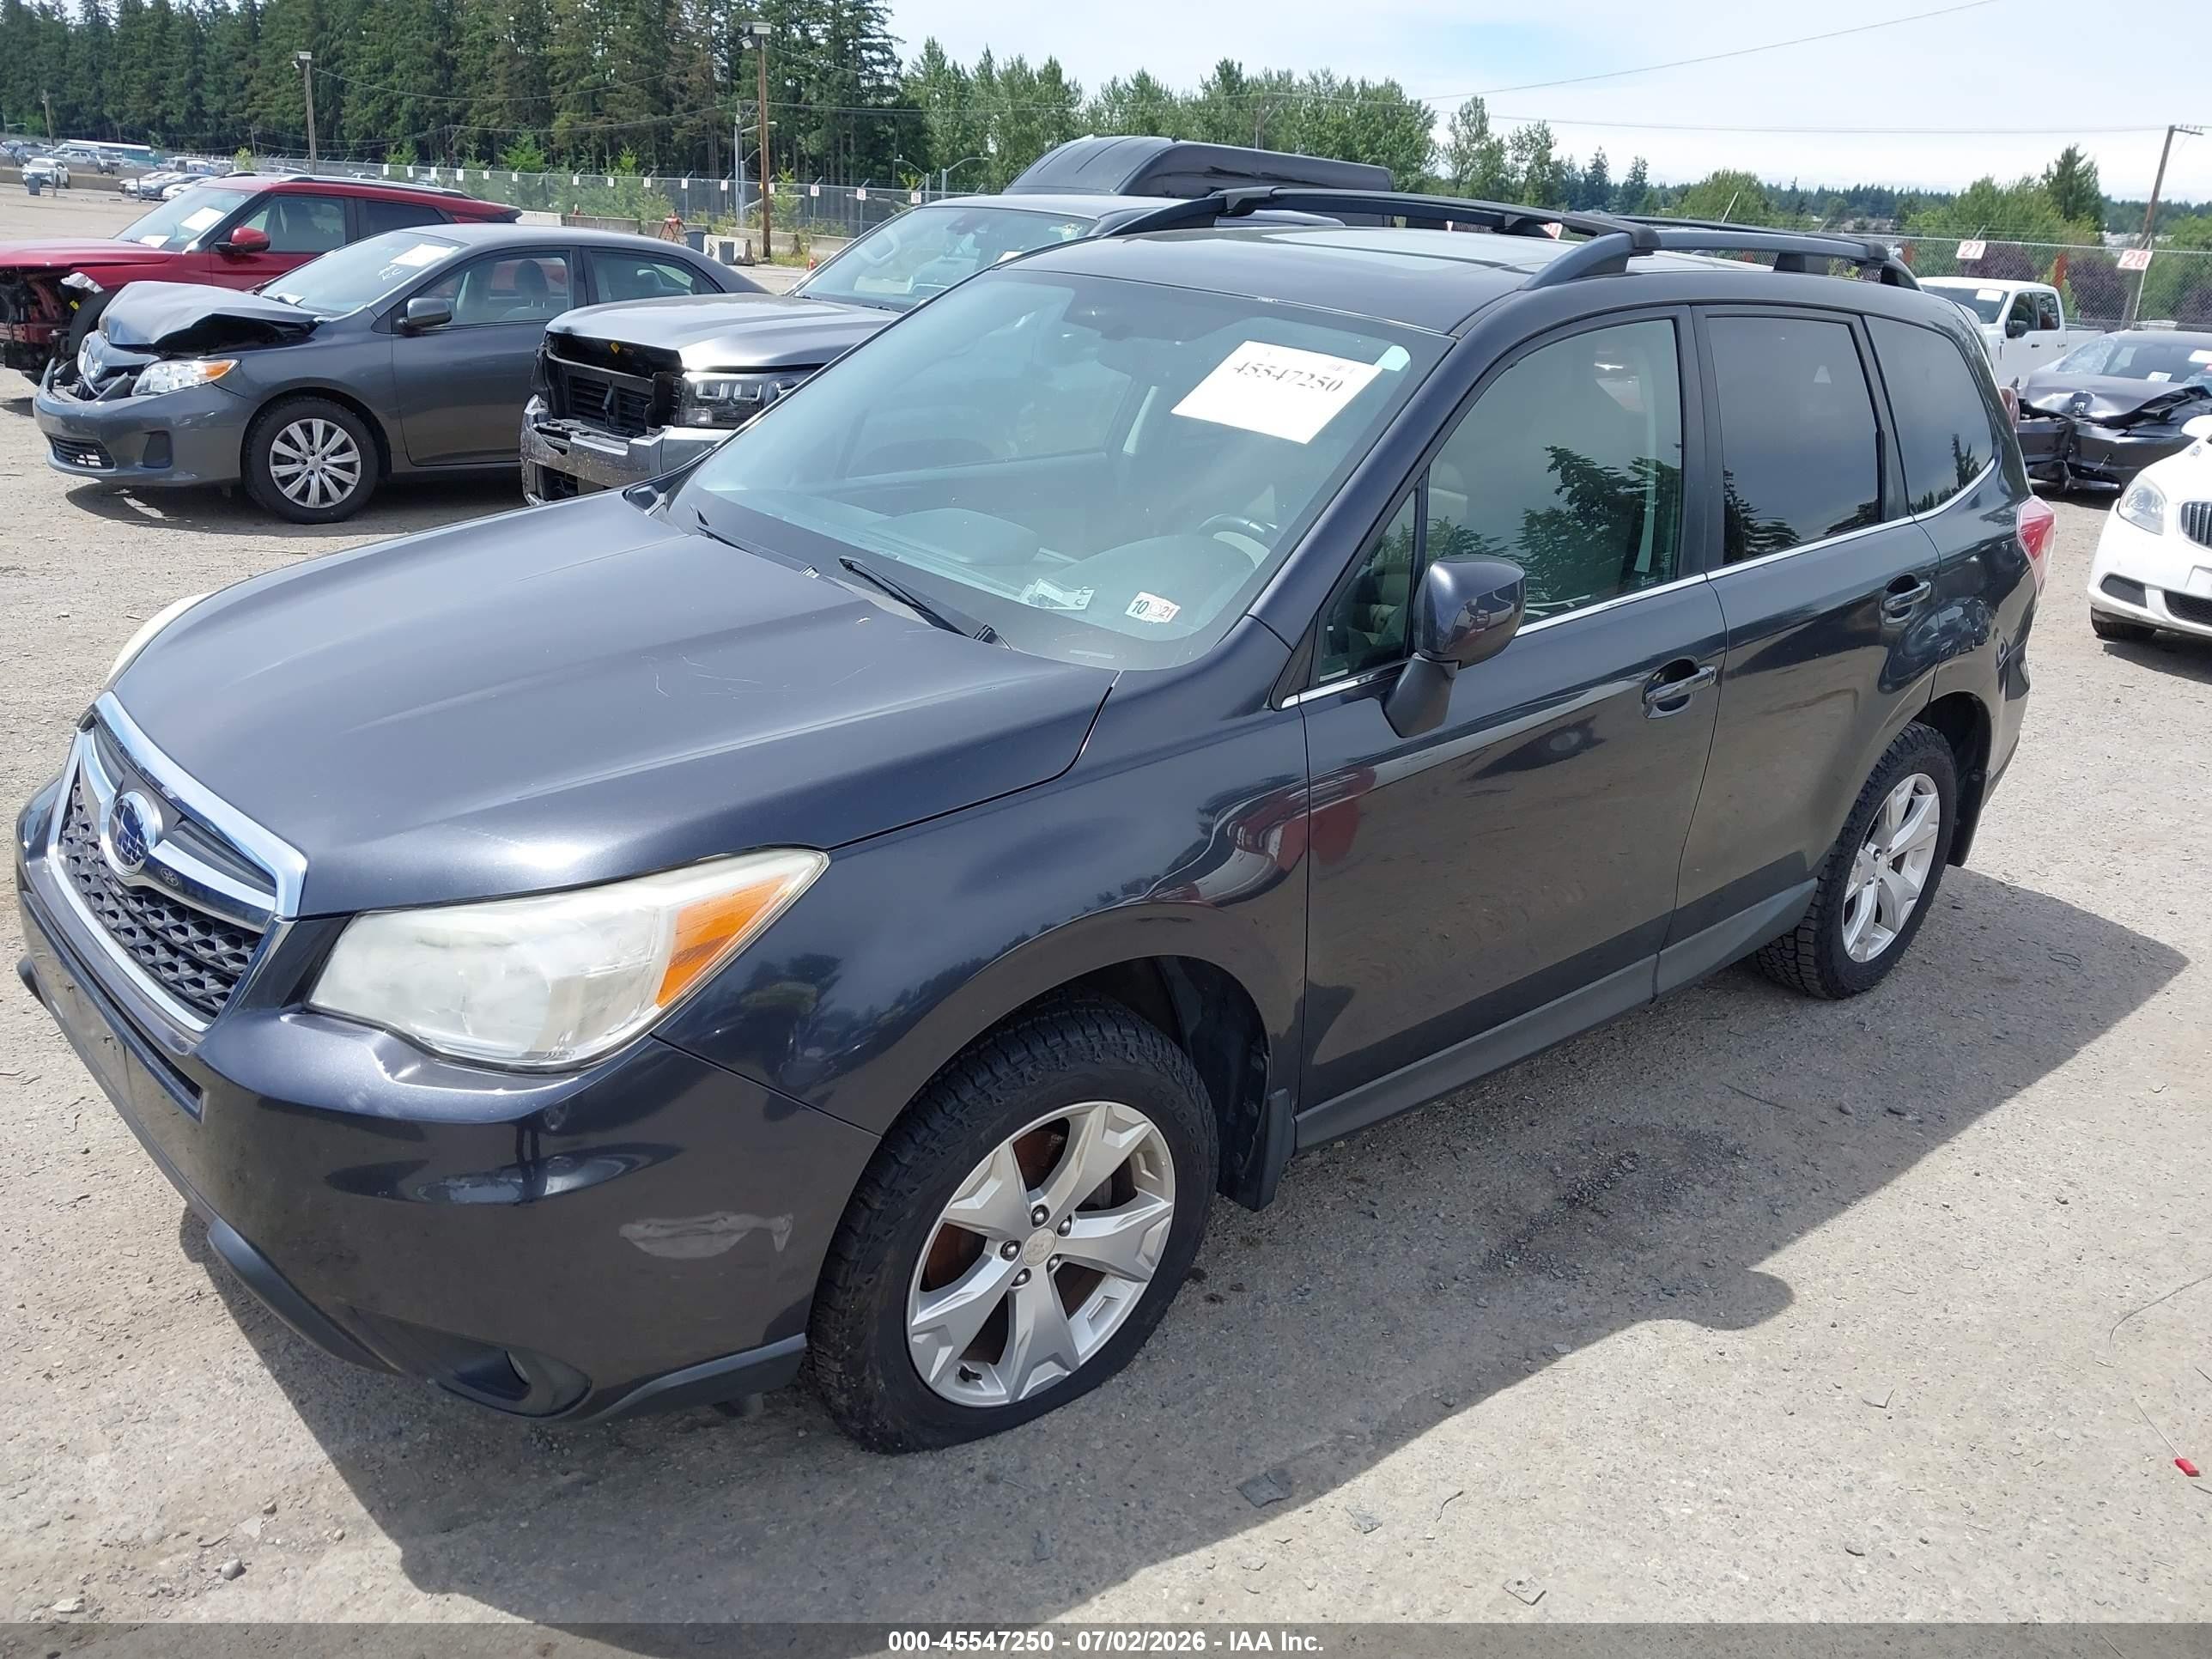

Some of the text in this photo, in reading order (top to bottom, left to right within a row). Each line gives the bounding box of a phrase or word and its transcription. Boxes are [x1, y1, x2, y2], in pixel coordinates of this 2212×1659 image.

[1960, 241, 1981, 257] 27
[2123, 252, 2148, 268] 28
[1232, 361, 1345, 392] 45547250
[1130, 599, 1173, 618] 10 21
